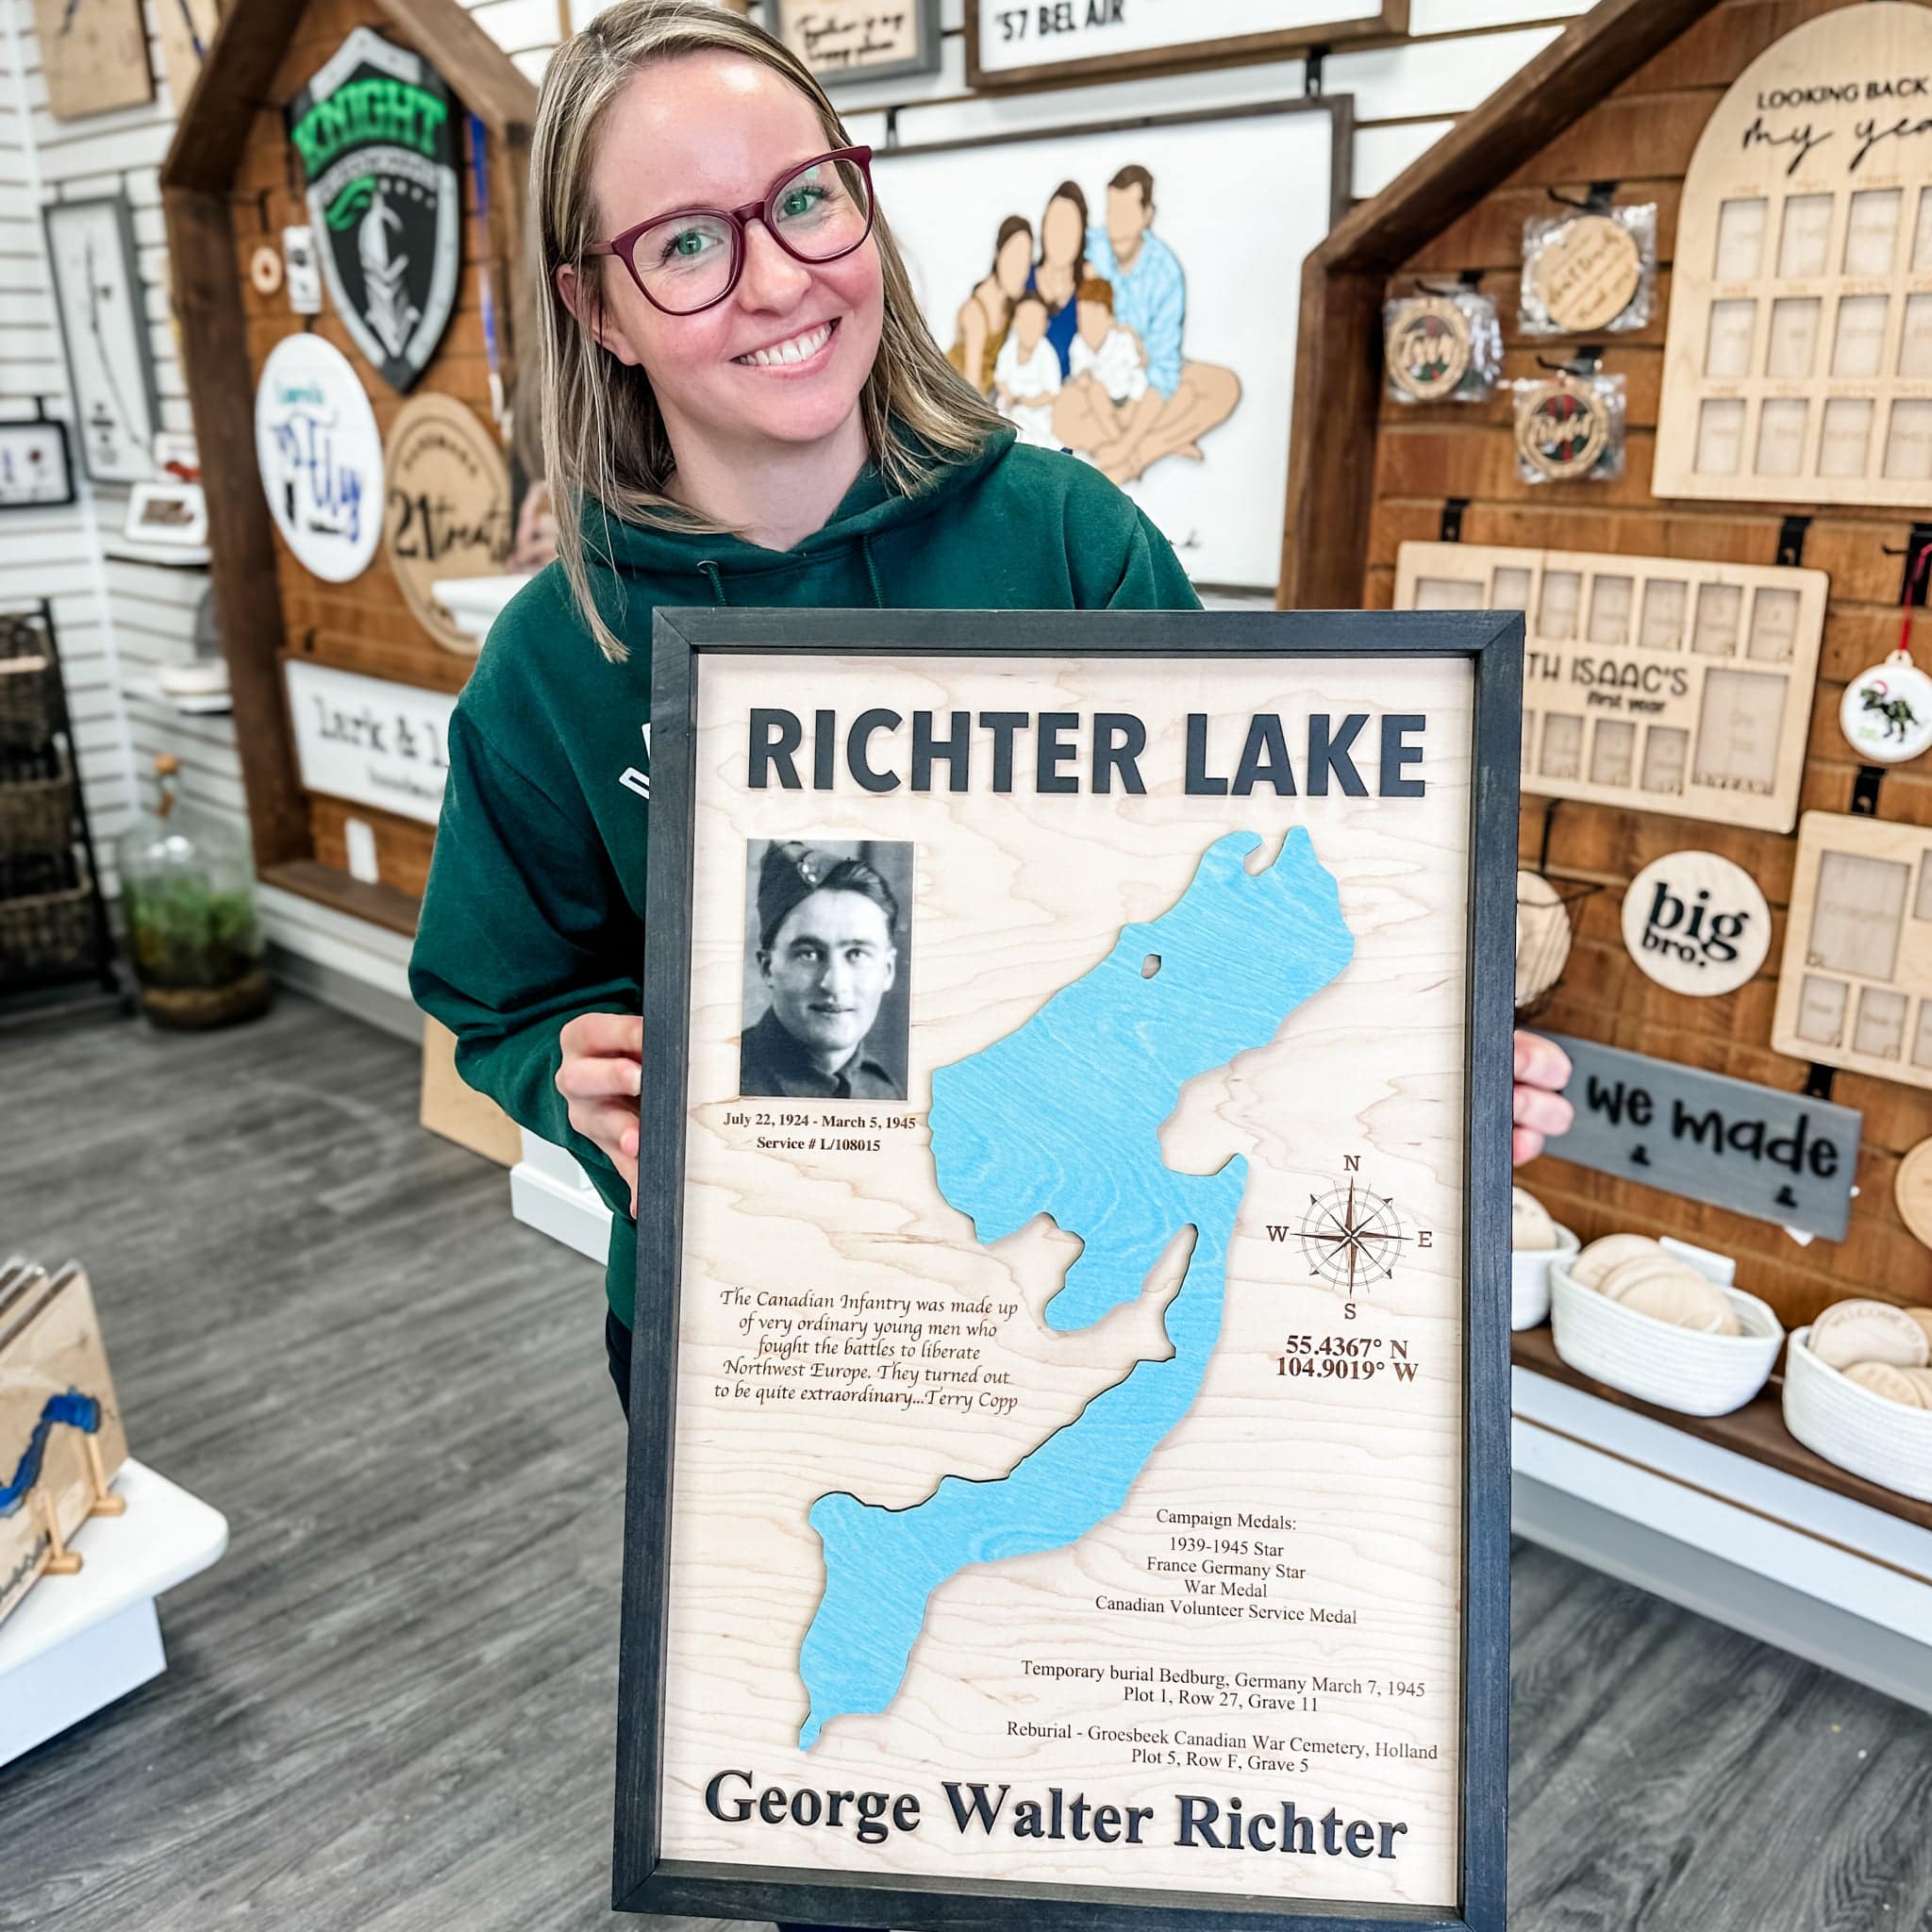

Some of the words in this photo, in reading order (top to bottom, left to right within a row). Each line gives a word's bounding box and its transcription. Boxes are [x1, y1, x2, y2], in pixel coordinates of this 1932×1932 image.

[1040, 3, 1076, 35] BEL
[1085, 0, 1124, 25] AIR
[1757, 83, 1858, 110] LOOKING
[1865, 76, 1930, 101] BACK
[292, 77, 448, 179] KNIGHT
[1742, 115, 1834, 176] my
[1572, 658, 1688, 696] ISAAC'S
[748, 708, 1147, 796] RICHTER
[1185, 713, 1425, 797] LAKE
[1650, 882, 1750, 962] big
[1641, 926, 1706, 968] bro.
[724, 1113, 751, 1127] July
[756, 1113, 774, 1126] 22,
[780, 1114, 808, 1126] 1924
[822, 1116, 865, 1127] March
[870, 1117, 881, 1129] 5,
[887, 1117, 916, 1129] 1945
[757, 1137, 805, 1149] Service
[808, 1139, 816, 1149] #
[821, 1139, 880, 1151] L/108015
[1671, 1099, 1839, 1178] made
[1343, 1155, 1361, 1172] N
[1266, 1225, 1290, 1241] W
[1418, 1231, 1432, 1247] E
[720, 1287, 751, 1305] The
[758, 1290, 833, 1307] Canadian
[841, 1291, 910, 1318] Infantry
[916, 1301, 944, 1311] was
[951, 1295, 992, 1313] made
[999, 1304, 1018, 1322] up
[1344, 1303, 1356, 1320] S
[740, 1311, 758, 1336] of
[758, 1319, 792, 1339] very
[798, 1313, 868, 1341] ordinary
[873, 1323, 922, 1343] young
[928, 1324, 960, 1336] men
[966, 1319, 996, 1337] who
[754, 1335, 809, 1361] fought
[815, 1337, 838, 1355] the
[844, 1338, 894, 1357] battles
[901, 1345, 915, 1357] to
[922, 1340, 980, 1359] liberate
[1286, 1335, 1381, 1357] 55.4367°
[1390, 1341, 1407, 1358] N
[724, 1356, 806, 1376] Northwest
[810, 1363, 872, 1387] Europe.
[877, 1361, 919, 1388] They
[924, 1365, 980, 1382] turned
[984, 1372, 1010, 1384] out
[1277, 1357, 1385, 1380] 104.9019°
[1393, 1362, 1419, 1382] W
[715, 1385, 729, 1397] to
[735, 1380, 750, 1397] be
[756, 1385, 795, 1405] quite
[979, 1392, 1018, 1415] Copp
[1157, 1509, 1232, 1529] Campaign
[1238, 1513, 1295, 1530] Medals:
[1172, 1537, 1248, 1555] 1939-1945
[1255, 1541, 1284, 1557] Star
[1147, 1557, 1196, 1573] France
[1202, 1559, 1271, 1580] Germany
[1276, 1564, 1306, 1578] Star
[1185, 1579, 1215, 1594] War
[1221, 1582, 1267, 1597] Medal
[1096, 1595, 1164, 1612] Canadian
[1170, 1600, 1244, 1617] Volunteer
[1249, 1605, 1304, 1621] Service
[1309, 1608, 1357, 1624] Medal
[1022, 1660, 1105, 1682] Temporary
[1110, 1665, 1153, 1681] burial
[1160, 1668, 1229, 1690] Bedburg,
[1235, 1673, 1306, 1693] Germany
[1312, 1676, 1361, 1693] March
[1368, 1680, 1381, 1695] 7,
[1390, 1682, 1424, 1696] 1945
[1124, 1687, 1154, 1702] Plot
[1162, 1689, 1173, 1704] 1,
[1179, 1690, 1214, 1705] Row
[1220, 1692, 1242, 1709] 27,
[1248, 1694, 1294, 1710] Grave
[1303, 1697, 1317, 1711] 11
[1008, 1722, 1071, 1739] Reburial
[1089, 1725, 1169, 1743] Groesbeek
[1174, 1731, 1246, 1748] Canadian
[1253, 1735, 1285, 1750] War
[1291, 1738, 1369, 1758] Cemetery,
[1375, 1742, 1438, 1759] Holland
[1132, 1749, 1161, 1763] Plot
[1167, 1751, 1180, 1767] 5,
[1187, 1752, 1222, 1766] Row
[1228, 1754, 1241, 1770] F,
[1248, 1756, 1294, 1772] Grave
[1300, 1758, 1308, 1773] 5
[706, 1770, 920, 1844] George
[941, 1781, 1154, 1843] Walter
[1174, 1794, 1407, 1858] Richter
